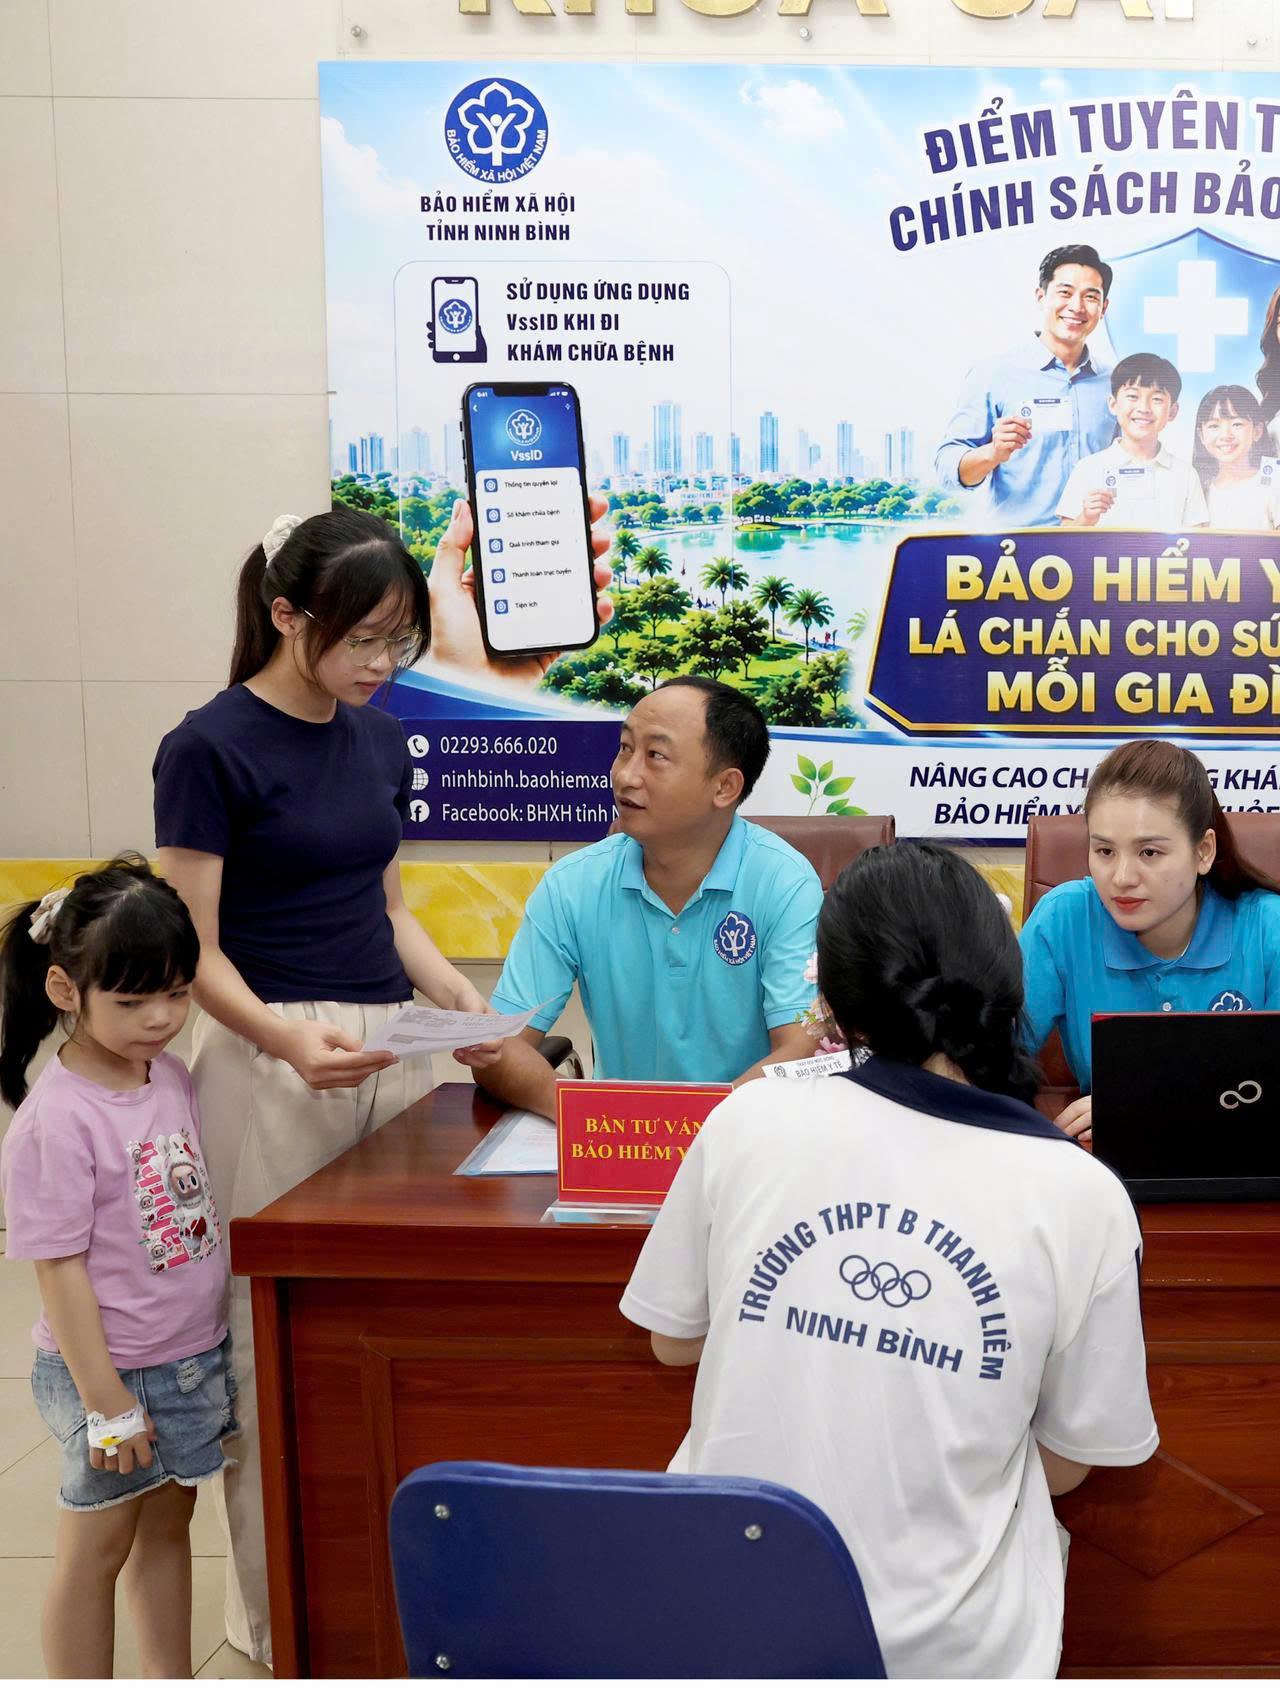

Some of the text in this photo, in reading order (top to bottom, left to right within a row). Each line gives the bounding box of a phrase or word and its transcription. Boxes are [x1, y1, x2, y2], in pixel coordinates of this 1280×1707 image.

[925, 97, 1057, 174] ĐIỂM
[1070, 89, 1239, 154] TUYÊN
[447, 129, 546, 182] BẢO HIỂM XÃ HỘI VIỆT NAM
[420, 189, 575, 217] BẢO HIỂM XÃ HỘI
[889, 178, 1034, 252] CHÍNH
[1049, 164, 1177, 221] SÁCH
[426, 218, 571, 242] TỈNH NINH BÌNH
[507, 276, 690, 305] SỬ DỤNG ỨNG DỤNG
[507, 313, 620, 331] VssID KHI ĐI
[507, 338, 674, 366] KHÁM CHỮA BỆNH
[511, 450, 543, 462] VssID
[945, 539, 1073, 602] BẢO
[1093, 538, 1241, 604] HIỂM
[908, 609, 966, 655] LÁ
[978, 606, 1110, 658] CHẮN
[1125, 619, 1220, 657] CHO
[987, 656, 1096, 713] MỖI
[1115, 672, 1214, 714] GIA
[440, 736, 557, 755] 02293.666.020
[441, 769, 612, 789] ninhbinh.baohiemxa
[910, 762, 1089, 788] NÂNG CAO CH
[442, 804, 524, 822] Facebook:
[527, 804, 572, 822] BHXH
[575, 803, 607, 822] tỉnh
[935, 797, 990, 825] BẢO
[995, 796, 1061, 825] HIỂM
[585, 1115, 704, 1136] BÀN TƯ VẤN
[572, 1140, 612, 1159] BẢO
[618, 1142, 671, 1160] HIỂM
[739, 1202, 1011, 1380] TRƯỜNG THPT B THANH LIÊM
[786, 1306, 963, 1373] NINH BÌNH
